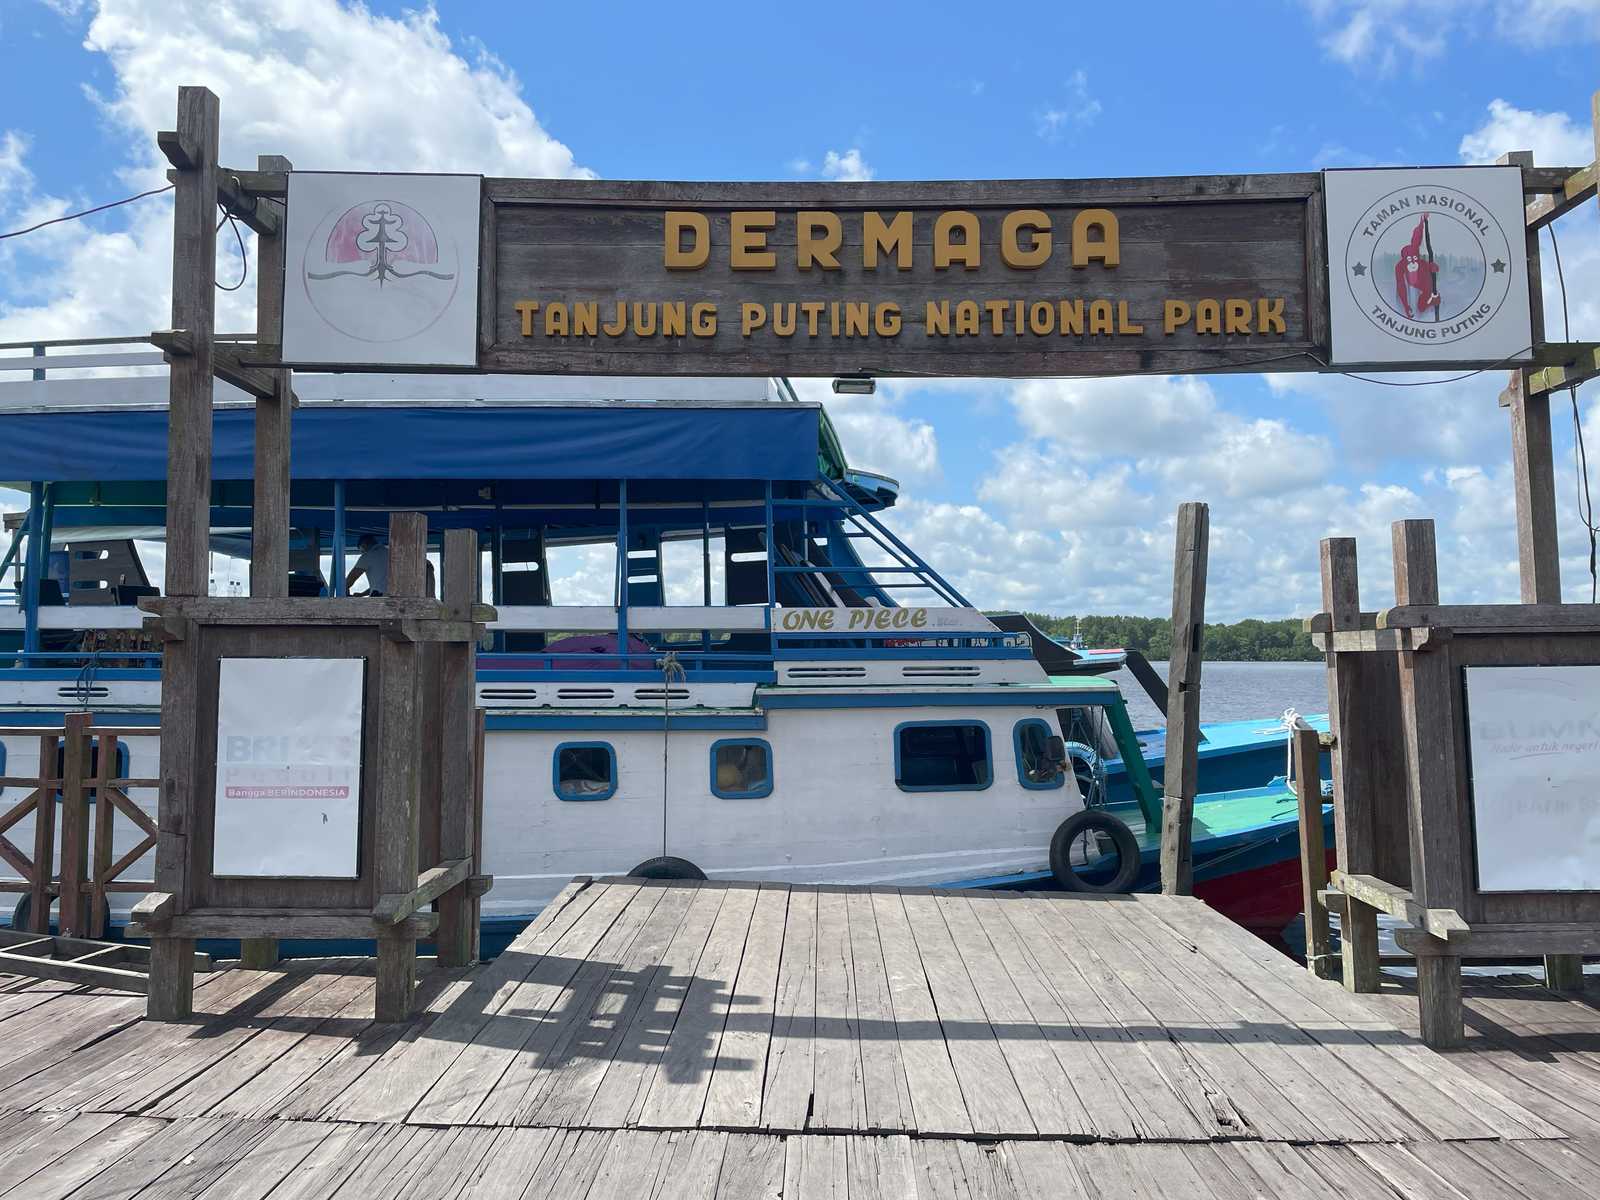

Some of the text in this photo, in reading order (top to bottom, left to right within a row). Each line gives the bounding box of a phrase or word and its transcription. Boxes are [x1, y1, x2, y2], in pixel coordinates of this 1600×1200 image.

[1363, 194, 1489, 238] TAMAN NASIONAL
[664, 208, 1120, 271] DERMAGA
[515, 298, 1287, 337] TANJUNG PUTING NATIONAL PARK
[1371, 303, 1491, 339] TANJUNG PUTING
[782, 608, 835, 630] ONE
[849, 607, 928, 630] PIECE
